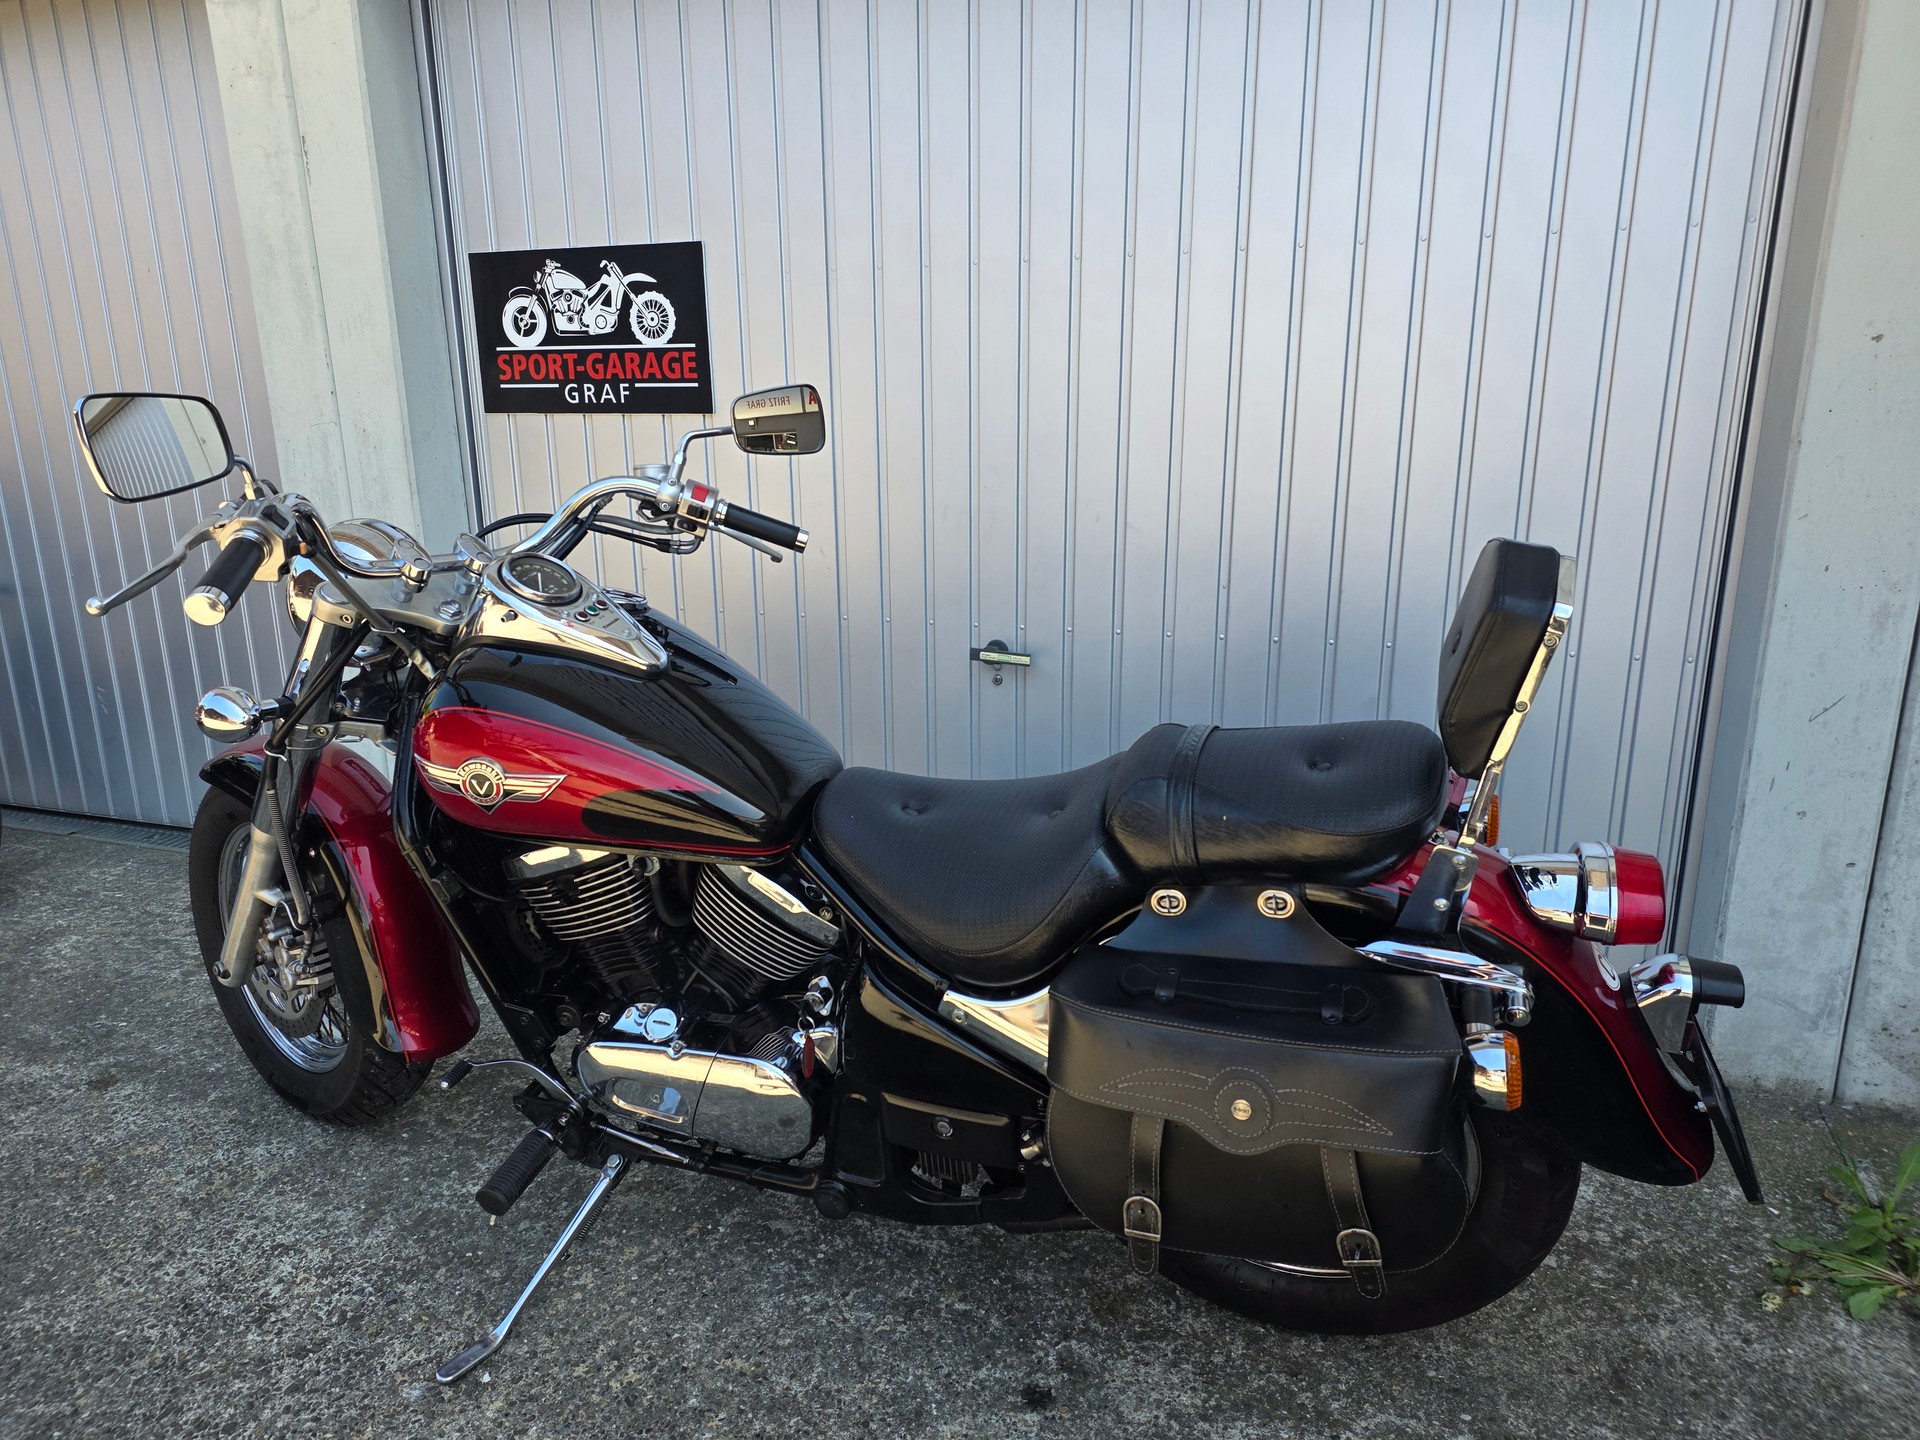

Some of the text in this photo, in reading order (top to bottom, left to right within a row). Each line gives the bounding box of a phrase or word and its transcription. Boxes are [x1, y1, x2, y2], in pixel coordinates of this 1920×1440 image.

[497, 351, 698, 381] SPORT-GARAGE
[564, 383, 630, 404] GRAF
[457, 762, 503, 783] Kawasaki
